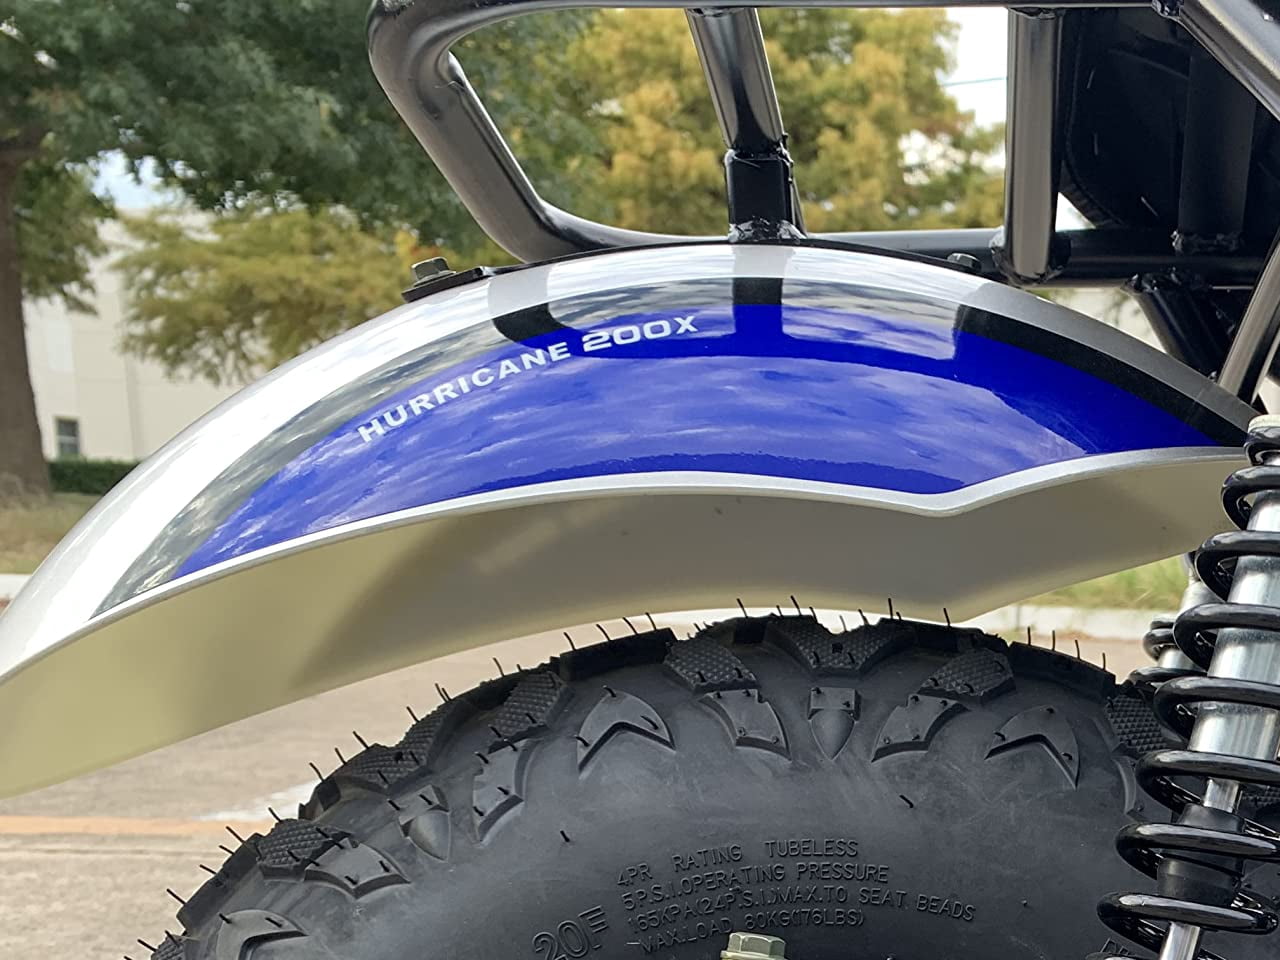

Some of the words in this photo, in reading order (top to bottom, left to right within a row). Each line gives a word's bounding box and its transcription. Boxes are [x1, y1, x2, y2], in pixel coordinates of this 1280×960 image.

[356, 341, 572, 444] HURRICANE
[582, 314, 699, 353] 200X
[616, 862, 653, 888] 4PR
[671, 843, 743, 873] RATING
[765, 838, 859, 858] TUBELESS
[796, 861, 890, 883] PRESSURE
[858, 886, 907, 909] SEAT
[916, 893, 977, 922] BEADS
